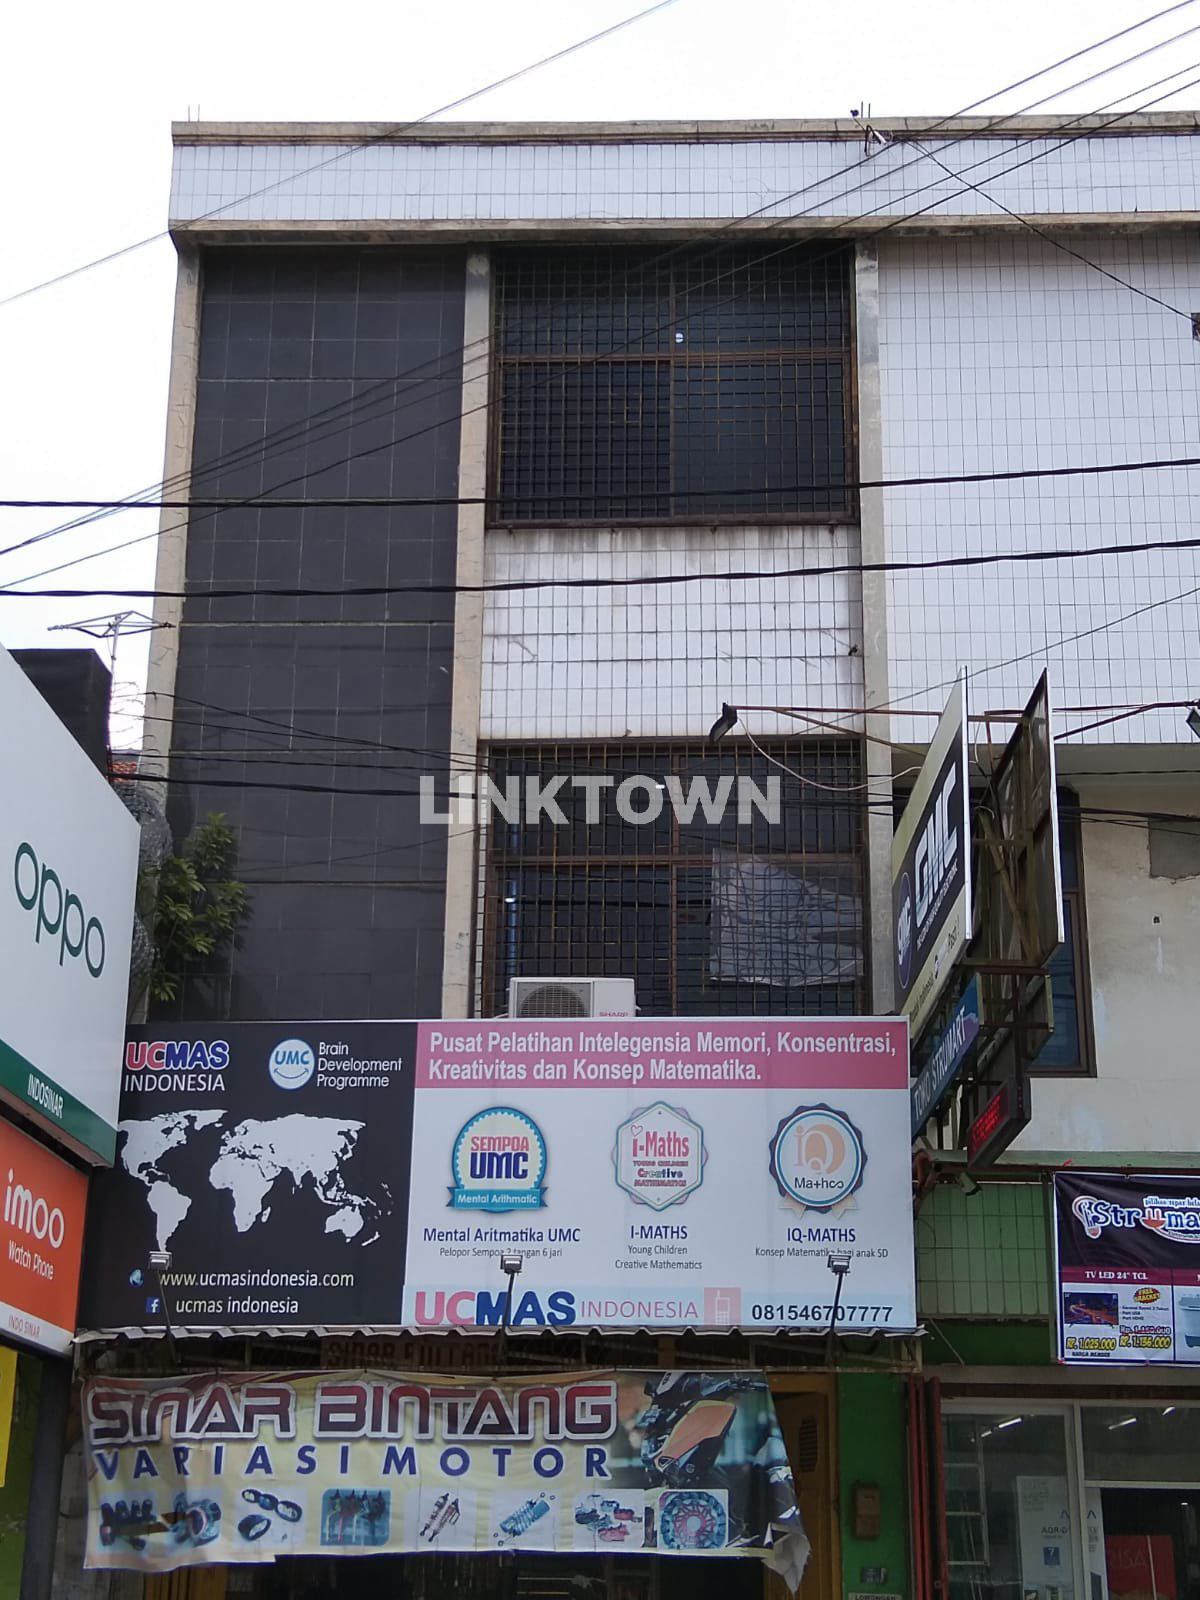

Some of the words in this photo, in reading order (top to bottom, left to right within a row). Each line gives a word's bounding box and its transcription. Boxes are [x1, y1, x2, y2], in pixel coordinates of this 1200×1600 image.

[14, 841, 105, 978] oppo
[318, 1041, 349, 1056] Brain
[430, 1033, 483, 1054] Pusat
[487, 1031, 575, 1054] Pelatihan
[579, 1031, 692, 1058] Intelegensia
[696, 1031, 772, 1057] Memori,
[777, 1031, 897, 1057] Konsentrasi,
[124, 1040, 230, 1071] UCMAS
[274, 1049, 311, 1066] UMC
[317, 1057, 402, 1075] Development
[428, 1058, 528, 1081] Kreativitas
[532, 1058, 568, 1081] dan
[573, 1058, 644, 1085] Konsep
[649, 1058, 762, 1081] Matematika.
[124, 1074, 226, 1093] INDONESIA
[316, 1074, 390, 1090] Programme
[27, 1073, 64, 1119] INDOSINAR
[470, 1136, 530, 1152] SEMPOA
[469, 1152, 529, 1179] UMC
[4, 1168, 64, 1248] imoo
[457, 1194, 489, 1204] Mental
[423, 1228, 470, 1242] Mental
[473, 1227, 544, 1242] Aritmatika
[548, 1228, 581, 1242] UMC
[630, 1225, 688, 1240] I-MATHS
[787, 1228, 856, 1243] IQ-MATHS
[440, 1247, 470, 1258] Pelopor
[543, 1248, 548, 1257] 6
[549, 1247, 563, 1258] jari
[628, 1245, 653, 1256] Young
[654, 1244, 688, 1255] Children
[755, 1247, 785, 1258] Konsep
[856, 1248, 875, 1258] anak
[877, 1248, 889, 1258] SD
[8, 1239, 32, 1270] Watch
[33, 1252, 54, 1280] Phone
[615, 1259, 649, 1269] Creative
[650, 1259, 703, 1270] Mathematics
[159, 1269, 354, 1287] www.ucmasindonesia.com
[1085, 1271, 1097, 1279] TV
[1099, 1271, 1115, 1279] LED
[176, 1300, 223, 1313] ucmas
[227, 1296, 299, 1313] indonesia
[415, 1291, 576, 1325] UCMAS
[581, 1300, 699, 1318] INDONESIA
[751, 1304, 893, 1322] 081546707777
[86, 1385, 296, 1444] SINAR
[313, 1380, 617, 1440] BINTANG
[95, 1444, 352, 1482] VARIASI
[383, 1444, 608, 1479] MOTOR
